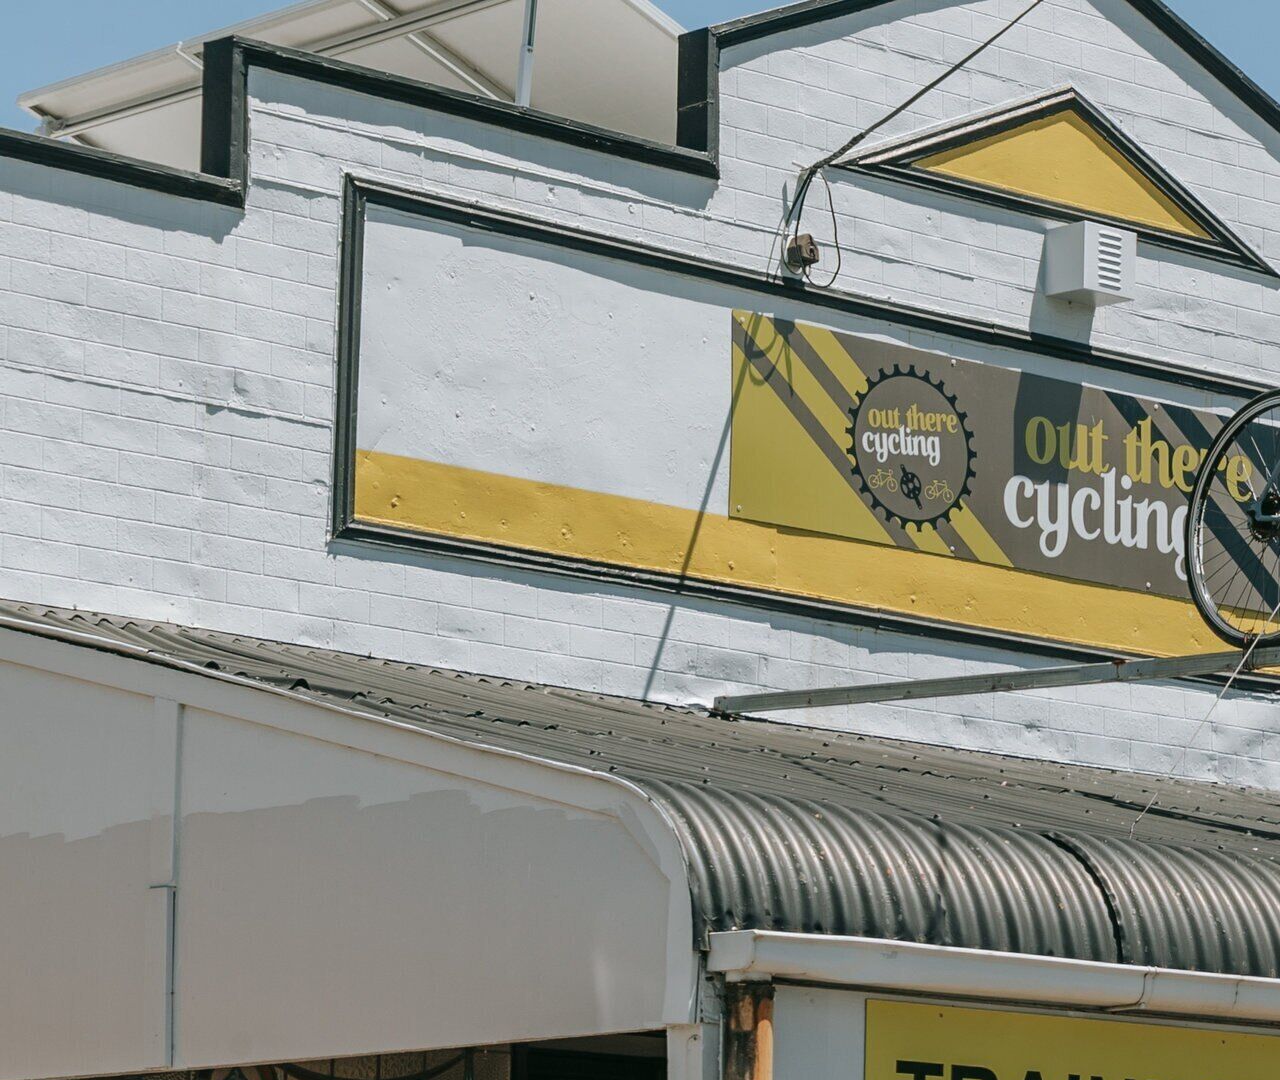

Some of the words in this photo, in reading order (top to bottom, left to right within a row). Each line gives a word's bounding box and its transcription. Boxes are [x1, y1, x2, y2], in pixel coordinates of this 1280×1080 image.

[868, 407, 901, 429] out
[906, 403, 958, 434] there
[862, 424, 941, 466] cycling
[1024, 415, 1110, 475] out
